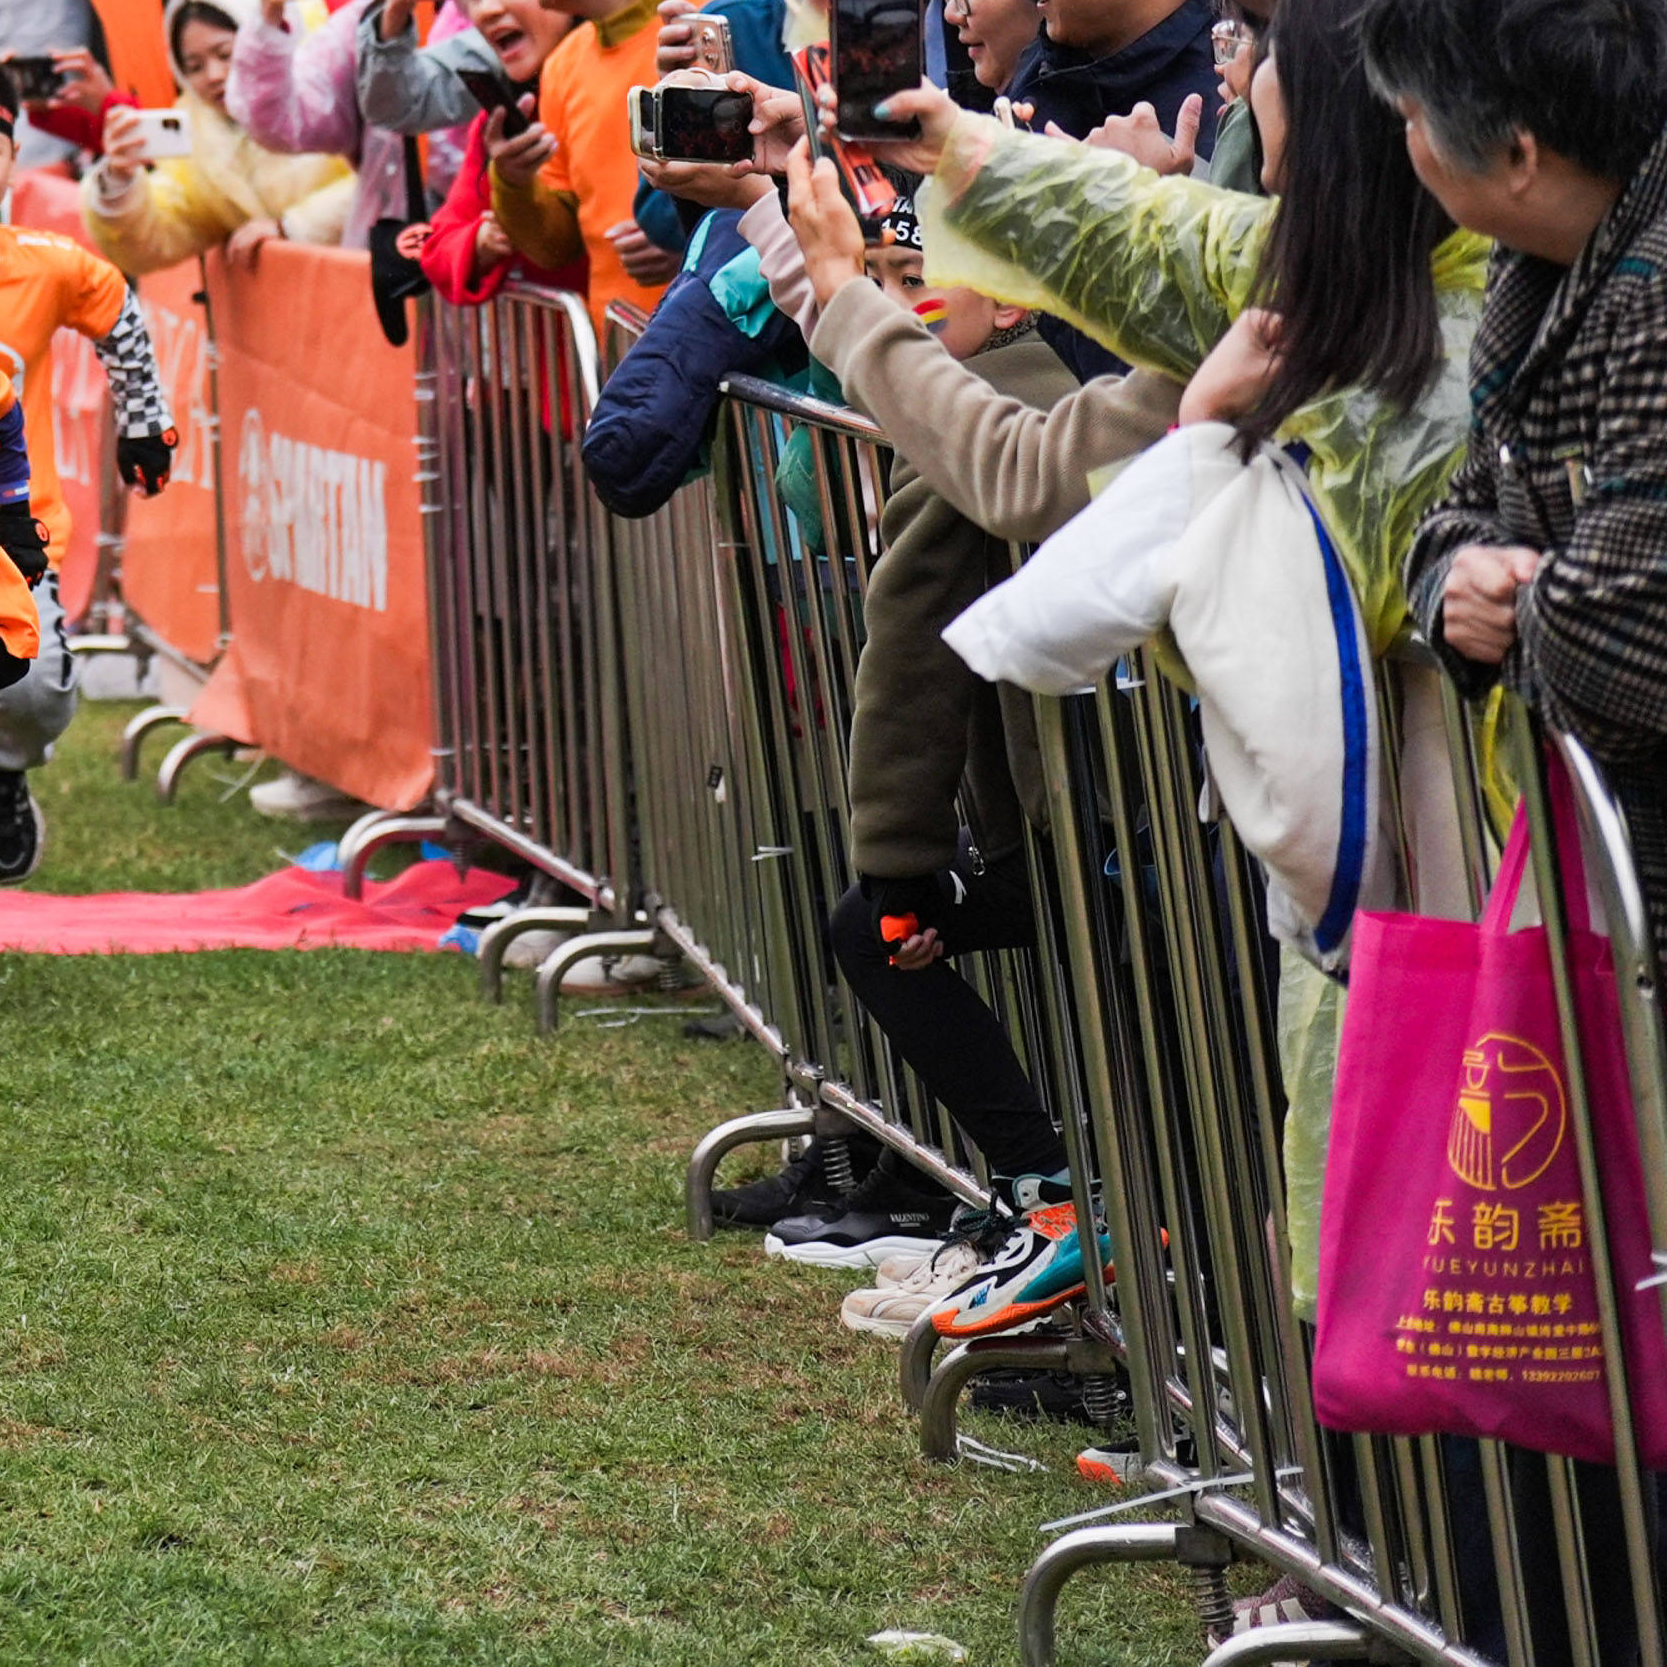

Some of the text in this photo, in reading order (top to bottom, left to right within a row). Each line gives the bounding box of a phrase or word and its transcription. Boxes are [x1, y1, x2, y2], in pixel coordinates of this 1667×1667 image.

[269, 432, 388, 613] SPARTAN
[1427, 1197, 1583, 1251] 乐韵斋
